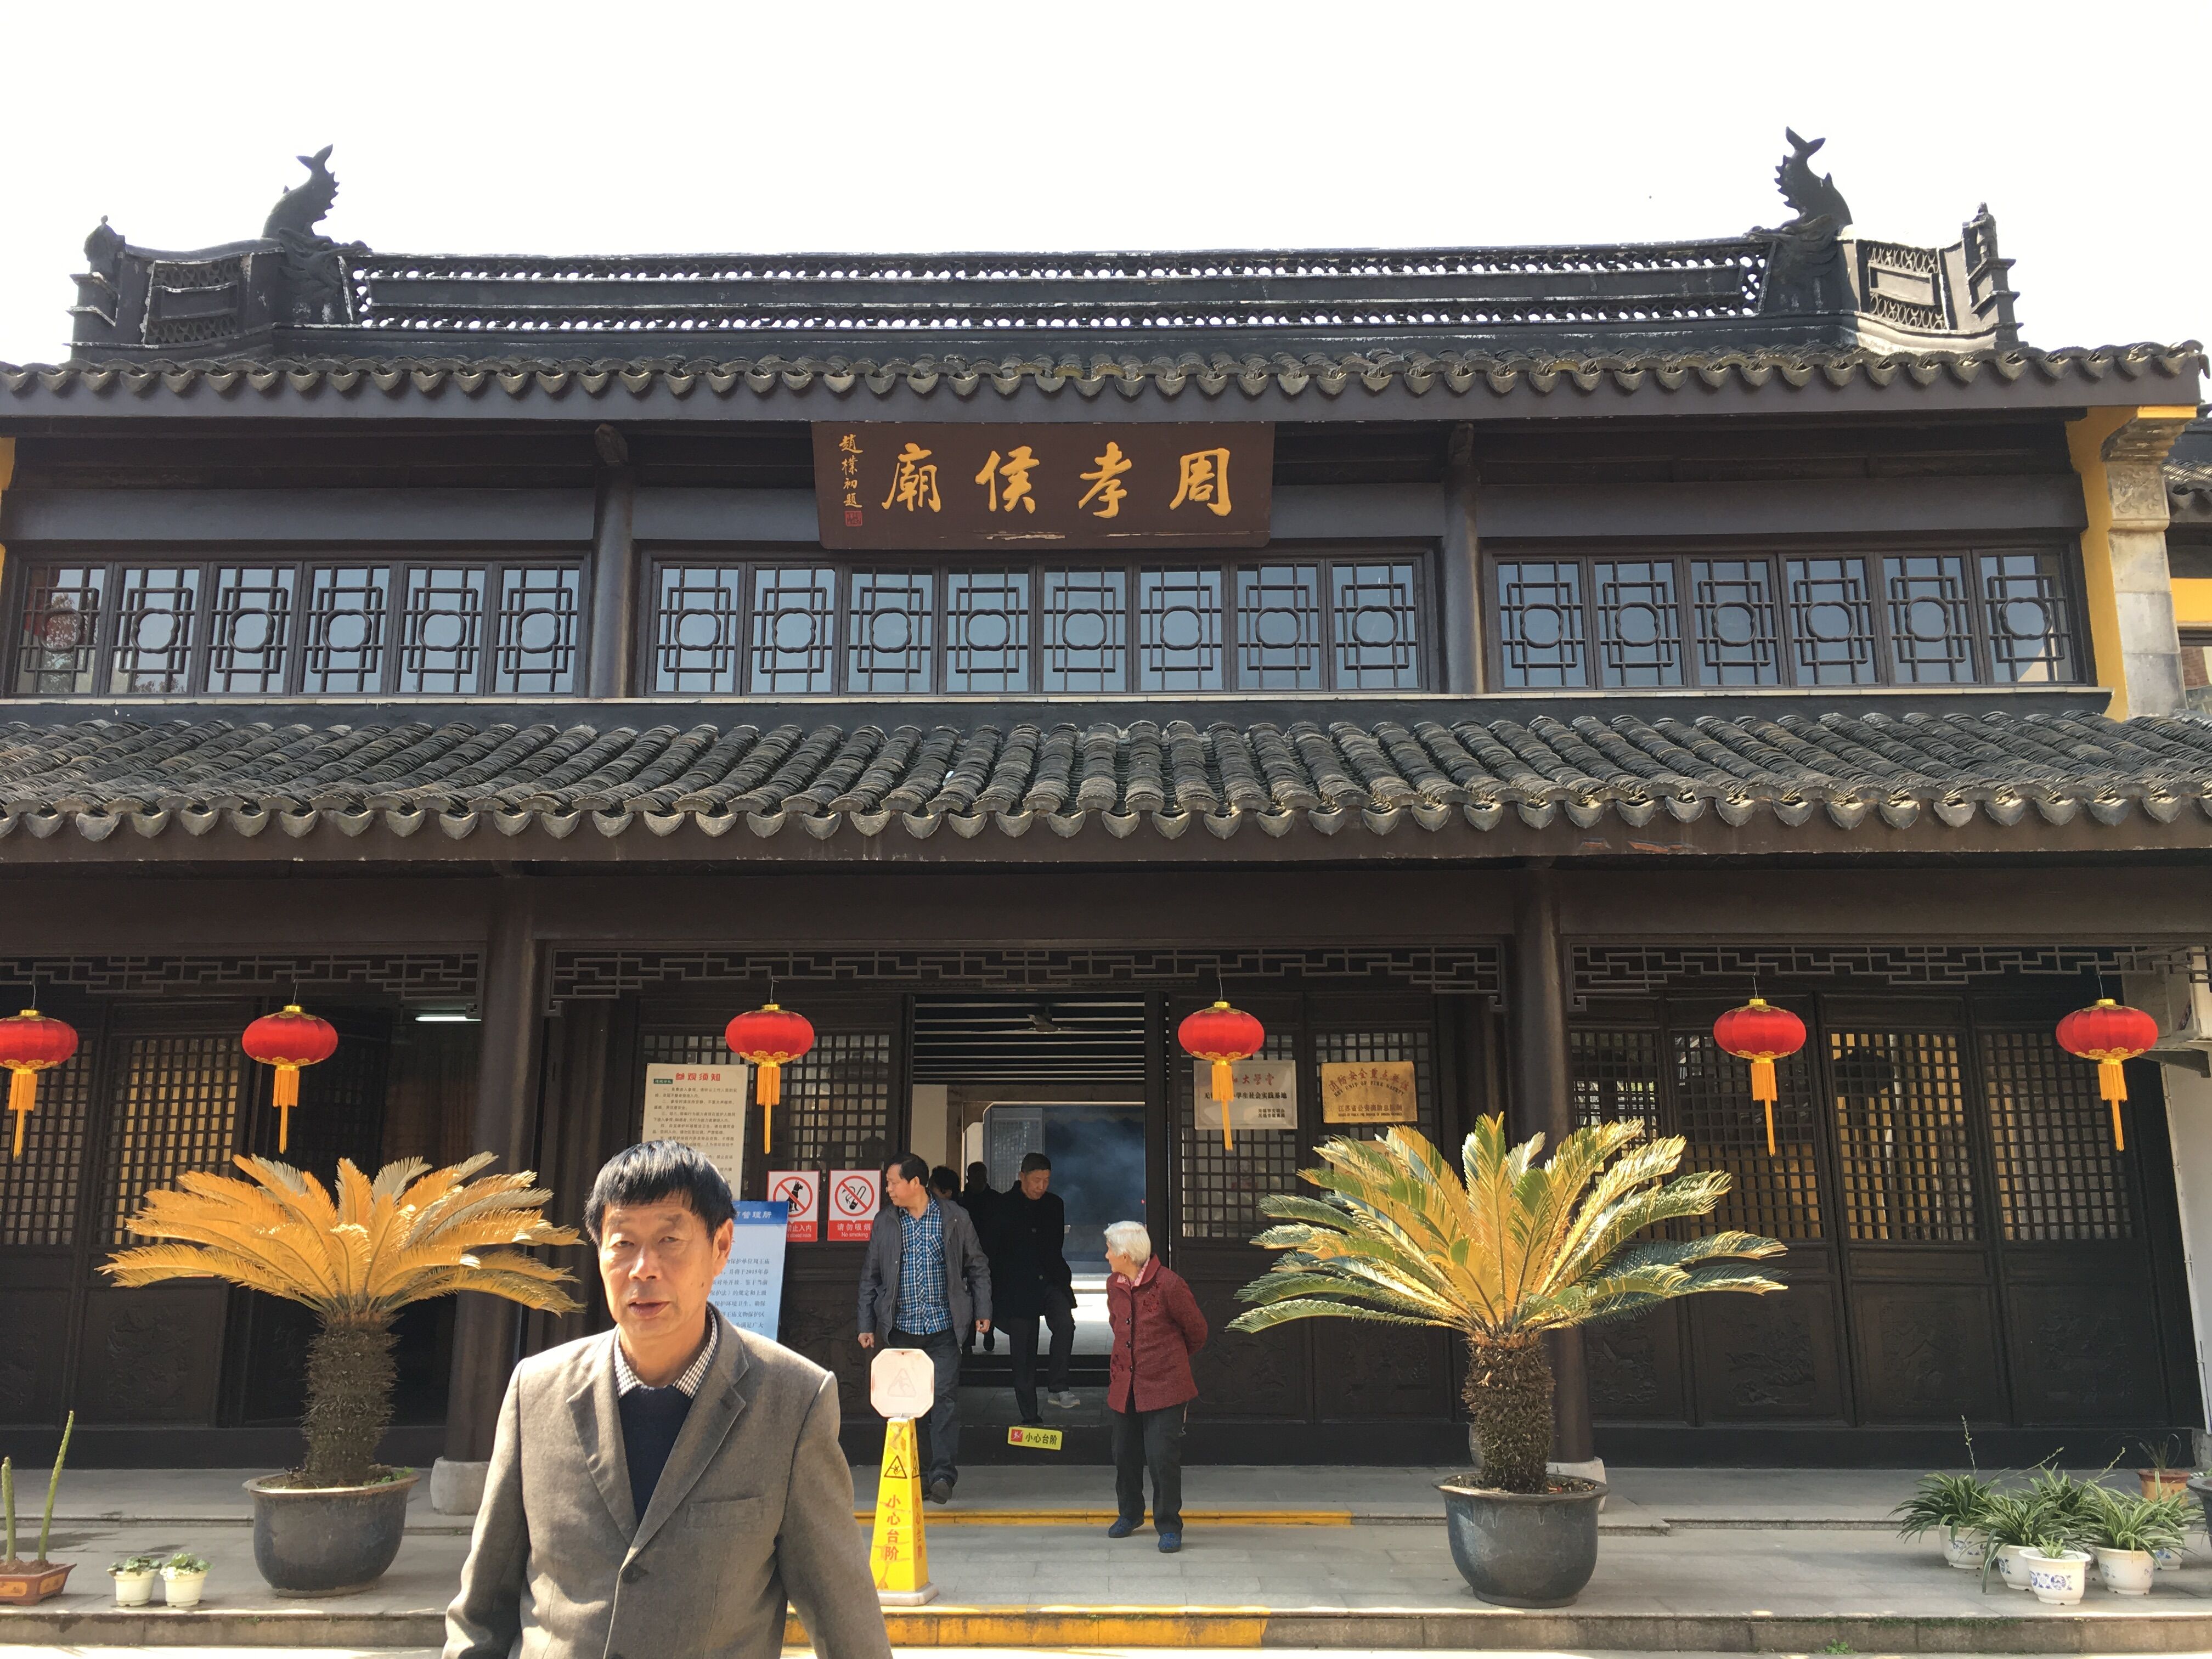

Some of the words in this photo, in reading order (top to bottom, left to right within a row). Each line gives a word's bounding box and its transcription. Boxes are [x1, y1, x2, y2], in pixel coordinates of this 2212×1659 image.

[675, 1073, 720, 1081] 参观须知
[1328, 1067, 1409, 1092] 消防安全重点单位
[1025, 1432, 1058, 1445] 小心台阶
[884, 1494, 901, 1561] 小心台阶
